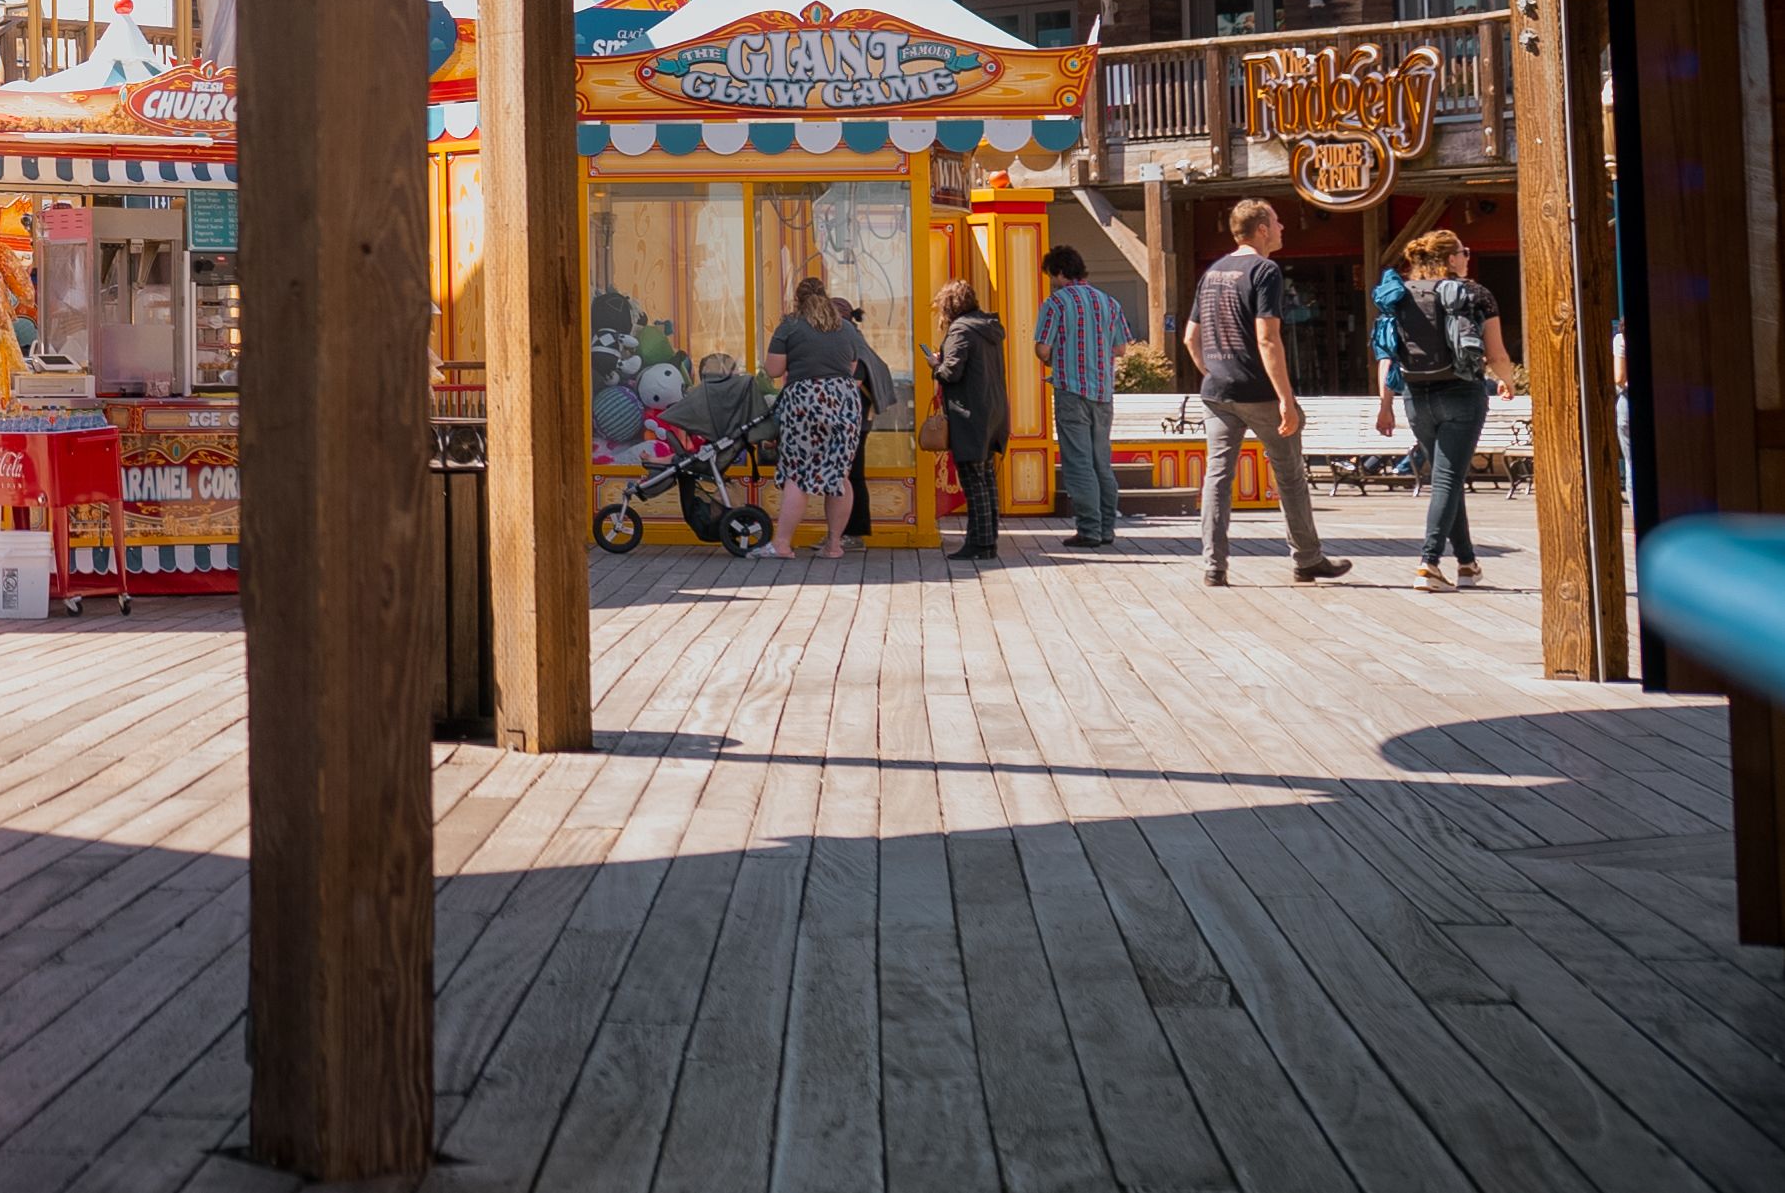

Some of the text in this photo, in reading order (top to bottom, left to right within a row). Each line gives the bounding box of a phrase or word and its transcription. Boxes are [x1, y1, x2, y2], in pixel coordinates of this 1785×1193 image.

[682, 29, 952, 82] THE GIANT FAMOUS
[1280, 48, 1309, 75] The
[191, 81, 224, 93] FRESH
[681, 68, 958, 108] CLAW GAME
[1243, 44, 1443, 183] Fudgery
[1314, 142, 1363, 169] FUDGE
[1316, 166, 1360, 192] & FUN
[188, 412, 222, 427] ICE
[121, 466, 192, 502] RAMEL
